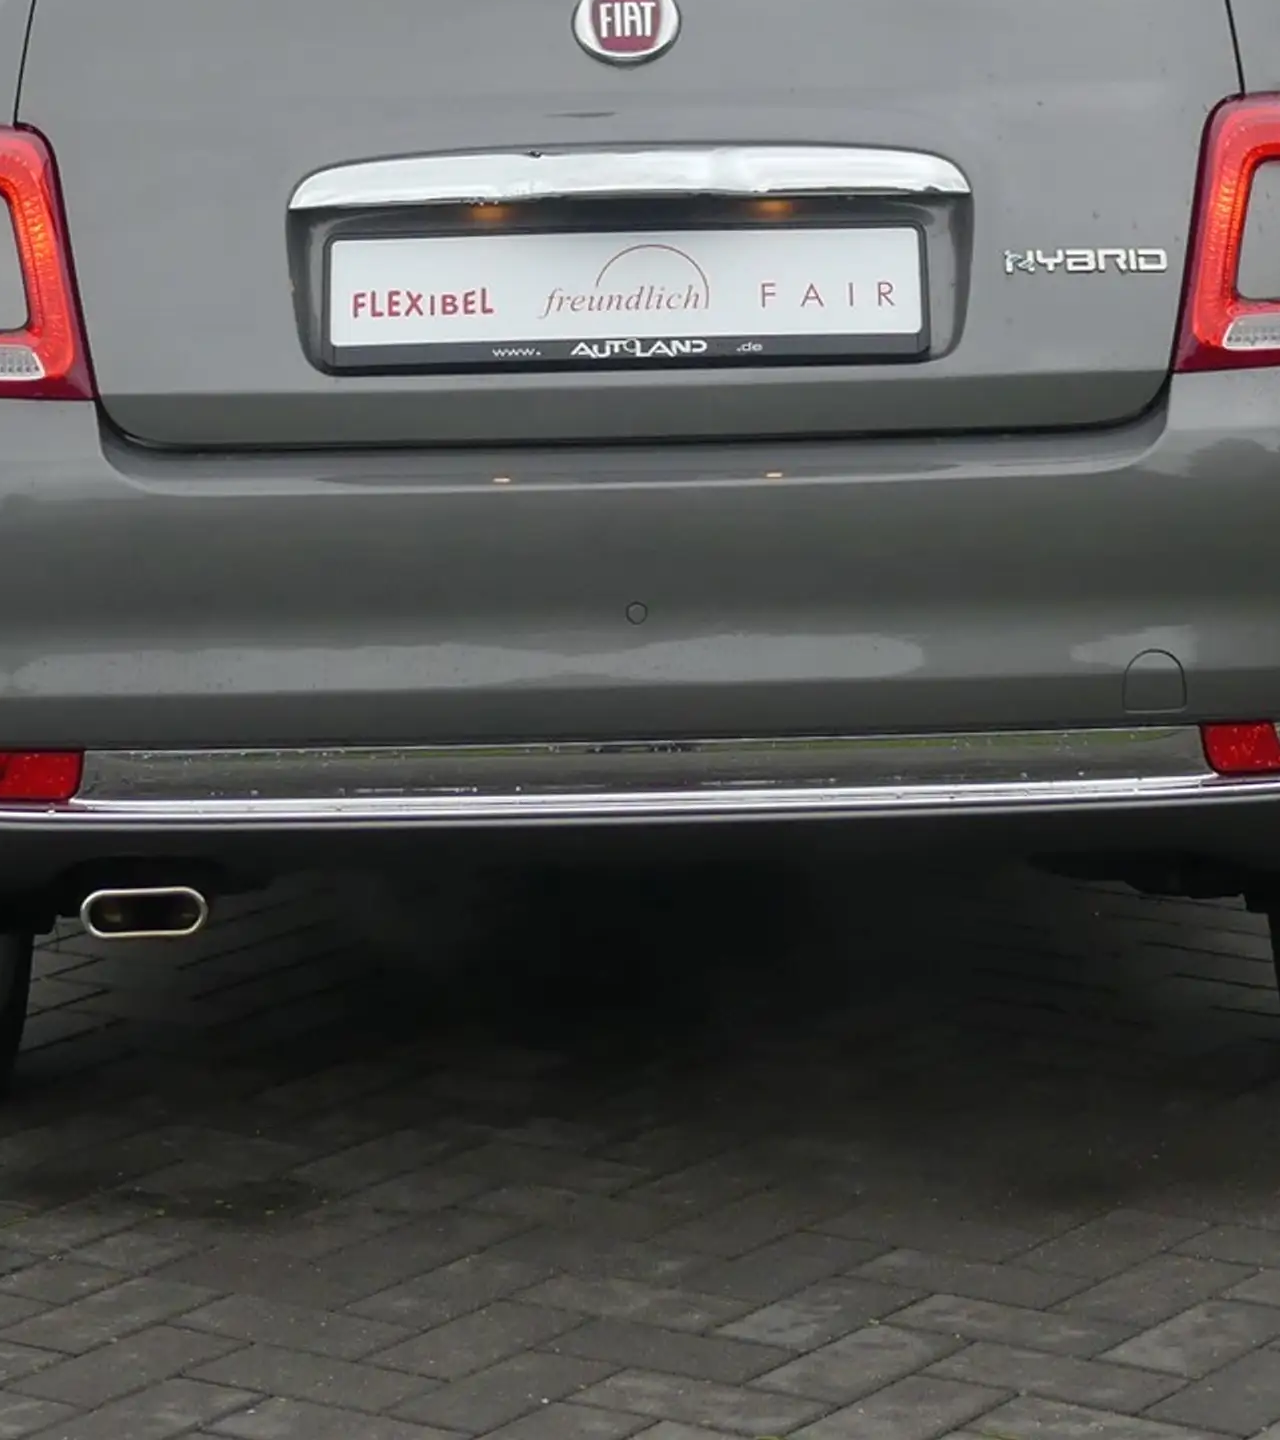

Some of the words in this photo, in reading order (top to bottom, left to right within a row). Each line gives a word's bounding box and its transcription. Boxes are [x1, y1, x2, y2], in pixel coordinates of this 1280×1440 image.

[599, 1, 656, 38] FIAT
[1003, 248, 1168, 273] HYBRID
[351, 286, 495, 319] FLEXIBEL
[538, 285, 703, 320] freundlich
[760, 280, 897, 308] FAIR
[491, 348, 542, 357] www.
[569, 337, 709, 359] AUTOLAND
[736, 340, 763, 353] .de
